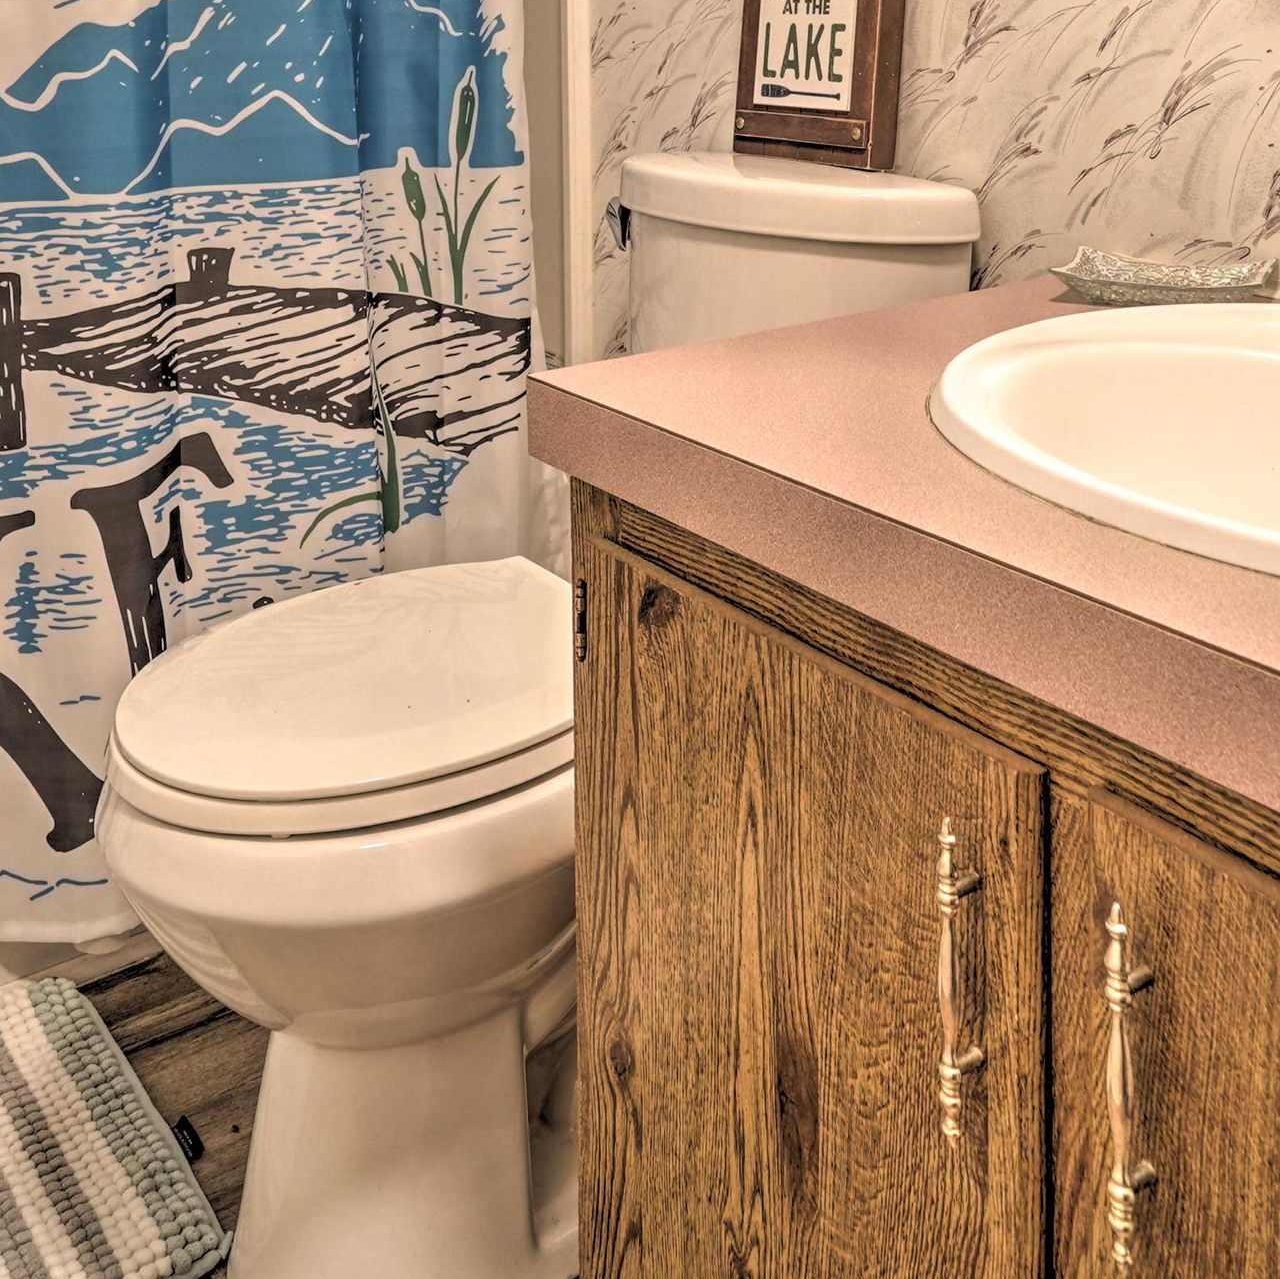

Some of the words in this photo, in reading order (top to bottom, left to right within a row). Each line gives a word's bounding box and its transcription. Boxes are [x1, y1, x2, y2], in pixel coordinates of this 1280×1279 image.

[782, 0, 801, 15] AT
[804, 0, 831, 15] THE
[762, 22, 847, 83] LAKE
